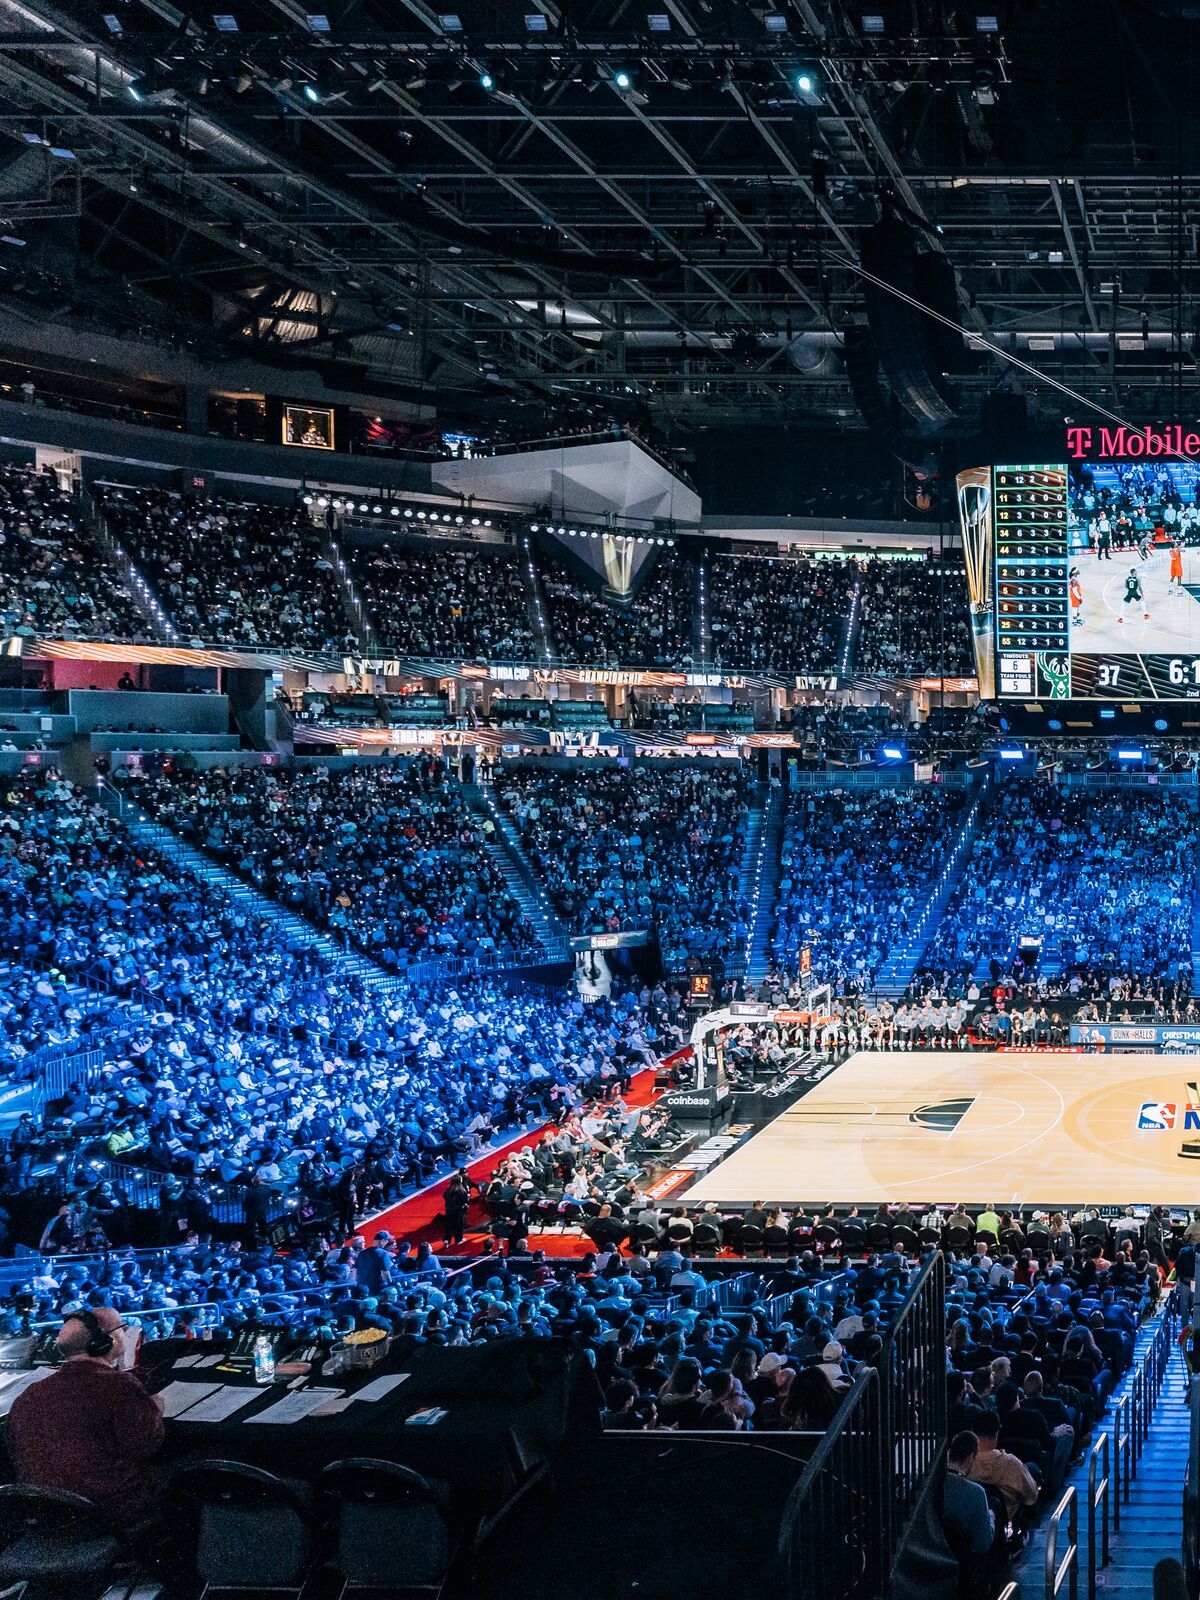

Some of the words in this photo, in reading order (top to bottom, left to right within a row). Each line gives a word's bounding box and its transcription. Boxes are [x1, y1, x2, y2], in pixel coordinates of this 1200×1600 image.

[1098, 425, 1200, 457] Mobile
[1012, 660, 1019, 671] 6
[578, 671, 644, 685] CHAMPIONSHIP
[1099, 665, 1120, 686] 37
[1013, 681, 1019, 691] 5
[1186, 690, 1200, 698] 2nd
[1113, 1029, 1130, 1040] DUNK
[1135, 1029, 1154, 1040] HALLS
[667, 1096, 710, 1106] coinbase
